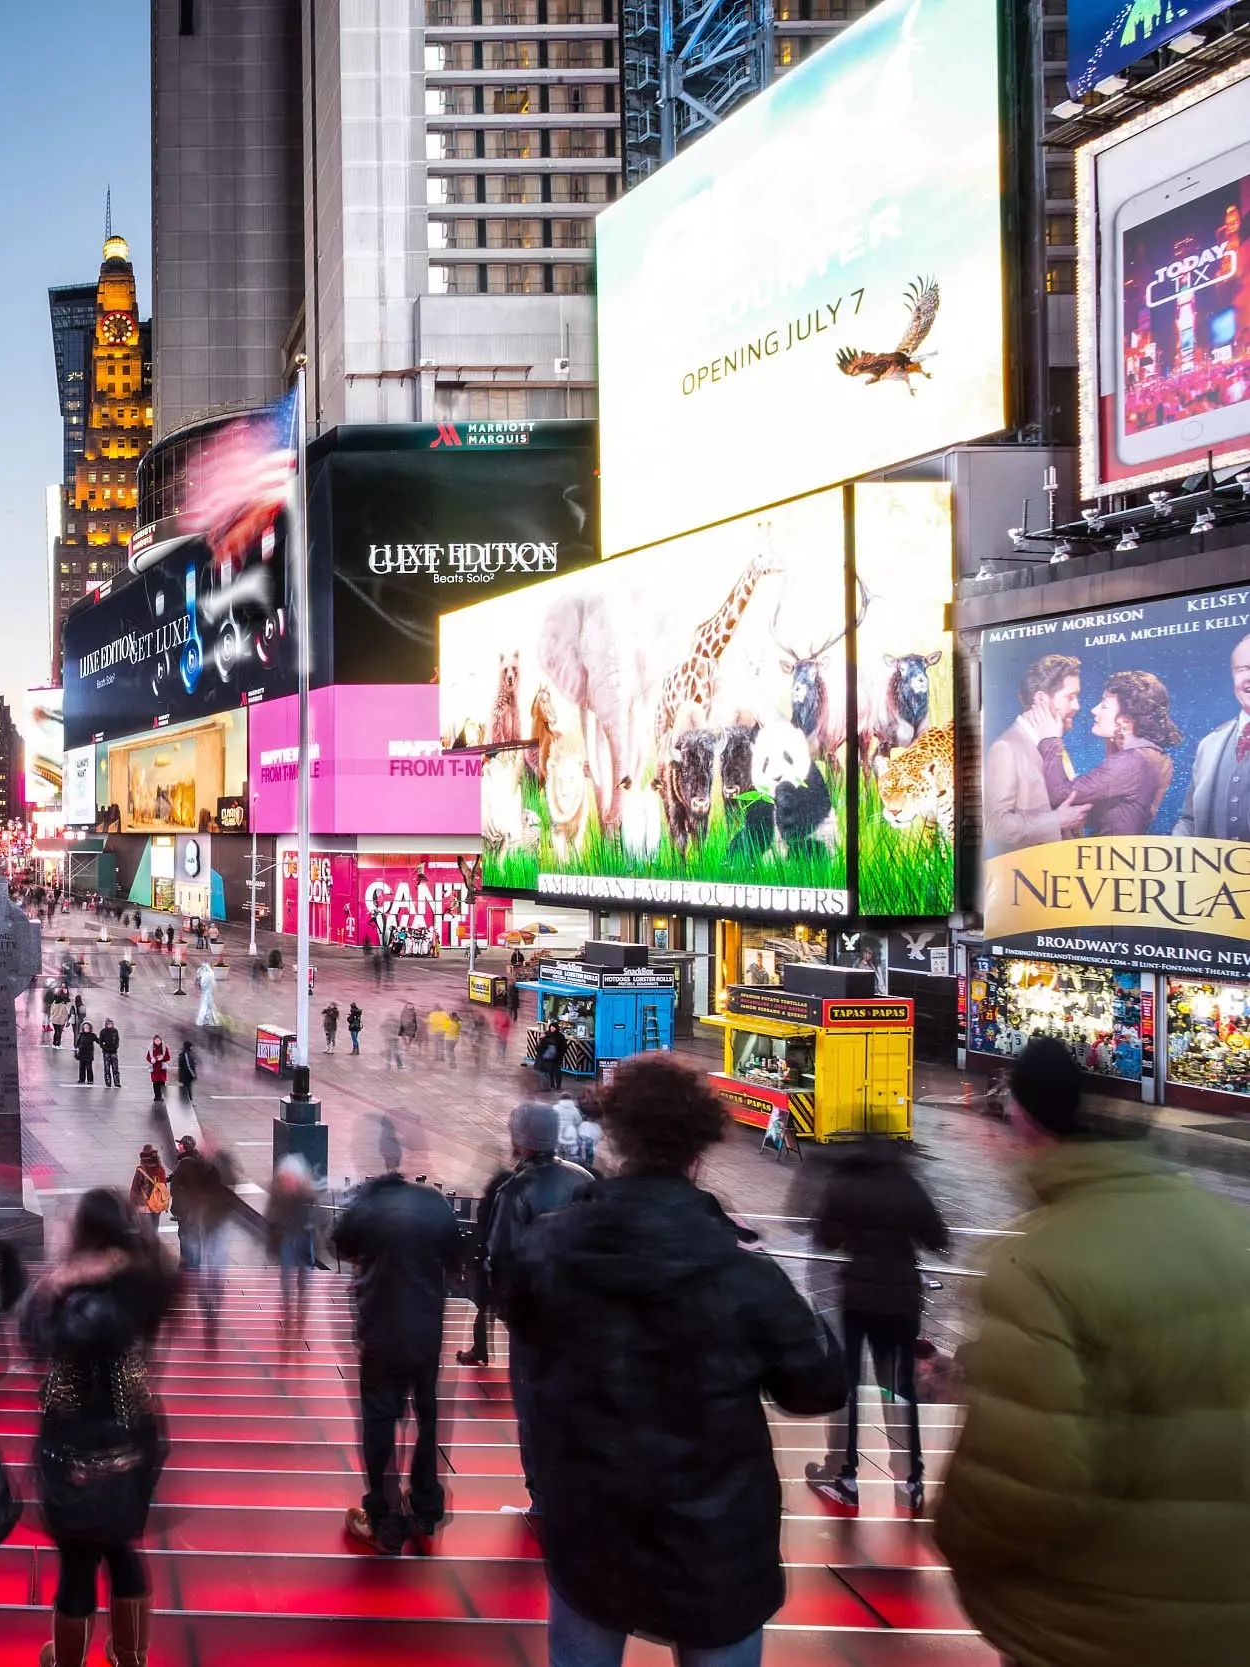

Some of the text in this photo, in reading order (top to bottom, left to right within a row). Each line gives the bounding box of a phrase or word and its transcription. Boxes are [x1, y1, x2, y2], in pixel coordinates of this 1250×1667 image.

[1155, 241, 1230, 284] TODAY
[1171, 264, 1211, 294] TIX
[682, 287, 866, 396] OPENING JULY 7
[468, 422, 535, 433] MARRIOTT
[468, 434, 527, 445] MARQUIS
[448, 542, 558, 567] EDITION
[433, 573, 464, 584] Beats
[1187, 591, 1250, 612] KELSEY
[988, 608, 1144, 643] MATTHEW MORRISON
[1085, 614, 1250, 648] LAURA MICHELLE KELLY
[130, 614, 191, 665] GET LUXE
[79, 631, 136, 679] LUXE EDITION
[261, 765, 282, 784] FROM
[390, 760, 444, 777] FROM
[364, 881, 470, 915] CAN'T
[538, 875, 847, 915] AMERICAN EAGLE OUTFITTERS
[1037, 935, 1129, 956] BROADWAY'S
[1133, 944, 1213, 963] SOARING
[541, 966, 563, 976] HOTDOGS
[583, 973, 598, 982] ROLLS
[556, 961, 583, 972] SnackBox
[622, 966, 655, 976] SnackBox
[832, 1009, 906, 1017] TAPAS PAPAS
[746, 1098, 772, 1112] PAPAS
